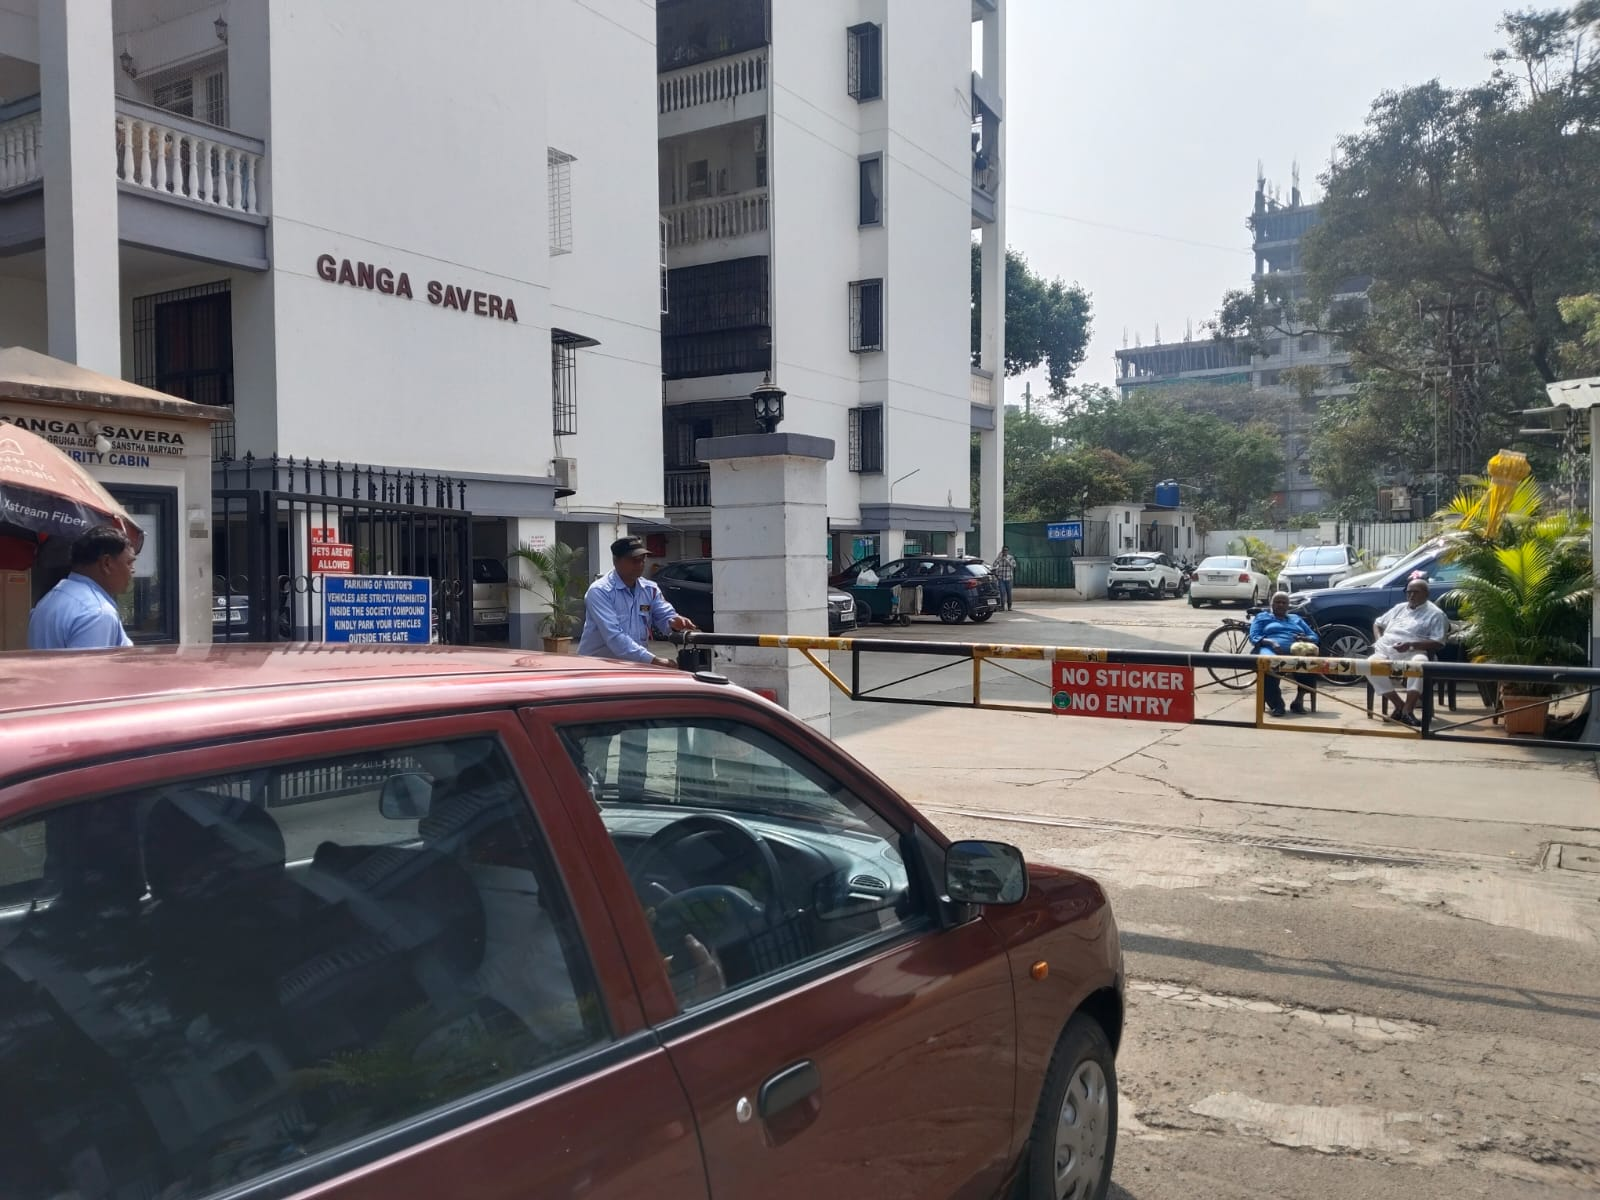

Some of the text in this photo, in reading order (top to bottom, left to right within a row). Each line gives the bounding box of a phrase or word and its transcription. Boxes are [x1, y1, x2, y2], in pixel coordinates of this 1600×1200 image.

[317, 254, 518, 322] GANGA SAVERA
[101, 426, 184, 444] SAVERA
[111, 441, 146, 453] SANSTHA
[147, 444, 183, 455] MARYADIT
[109, 453, 150, 467] CABIN
[4, 498, 88, 527] Xstream Fiber
[312, 547, 330, 556] PETS
[331, 547, 343, 557] ARE
[318, 559, 350, 569] ALLOWED
[344, 579, 373, 590] PARKING
[373, 580, 383, 590] OF
[327, 593, 427, 604] VEHICLES ARE STRICTLY PROHIBITED
[329, 606, 425, 617] INSIDE THE SOCIETY COMPOUND
[334, 619, 422, 631] KINDLY PARK YOUR VEHICLES
[348, 631, 409, 643] OUTSIDE THE GATE
[1061, 667, 1184, 691] NO STICKER
[1071, 692, 1173, 716] NO ENTRY
